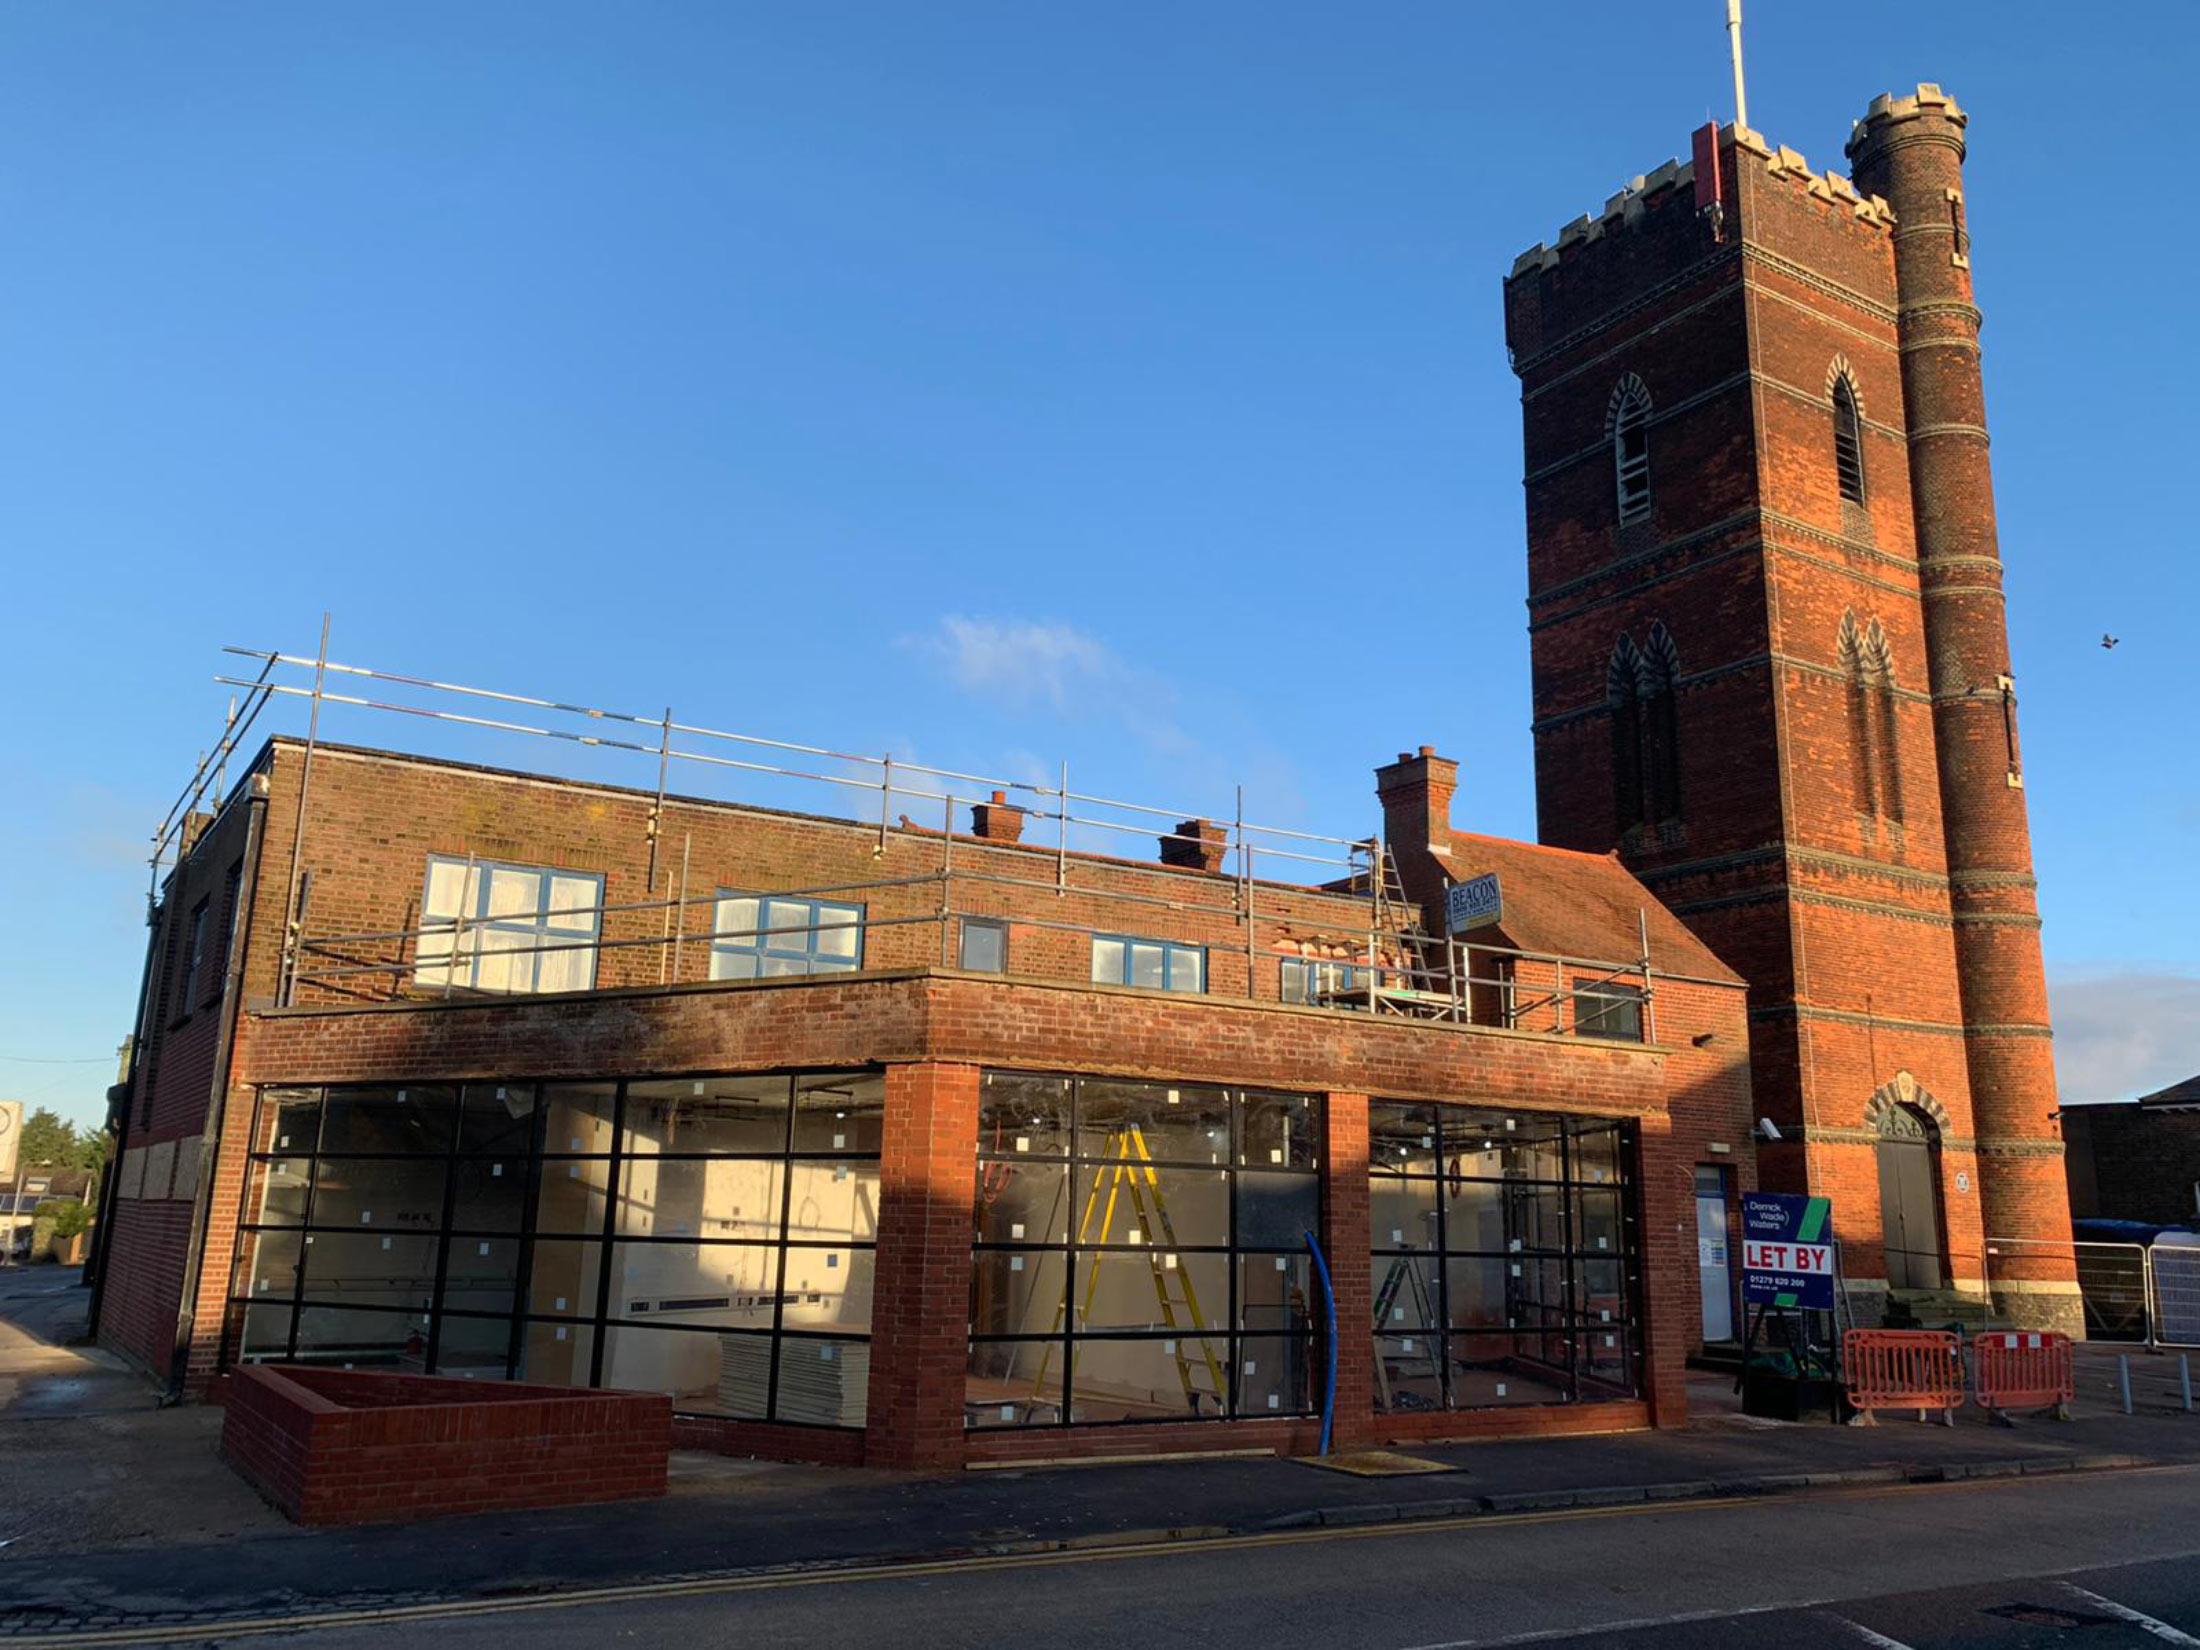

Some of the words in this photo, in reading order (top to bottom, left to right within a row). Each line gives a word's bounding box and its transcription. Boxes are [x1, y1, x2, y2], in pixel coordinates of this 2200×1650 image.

[1453, 880, 1497, 907] BEACON
[1750, 1201, 1781, 1212] Derrick
[1749, 1219, 1780, 1230] Waters
[1746, 1244, 1788, 1269] LET
[1796, 1247, 1826, 1271] BY
